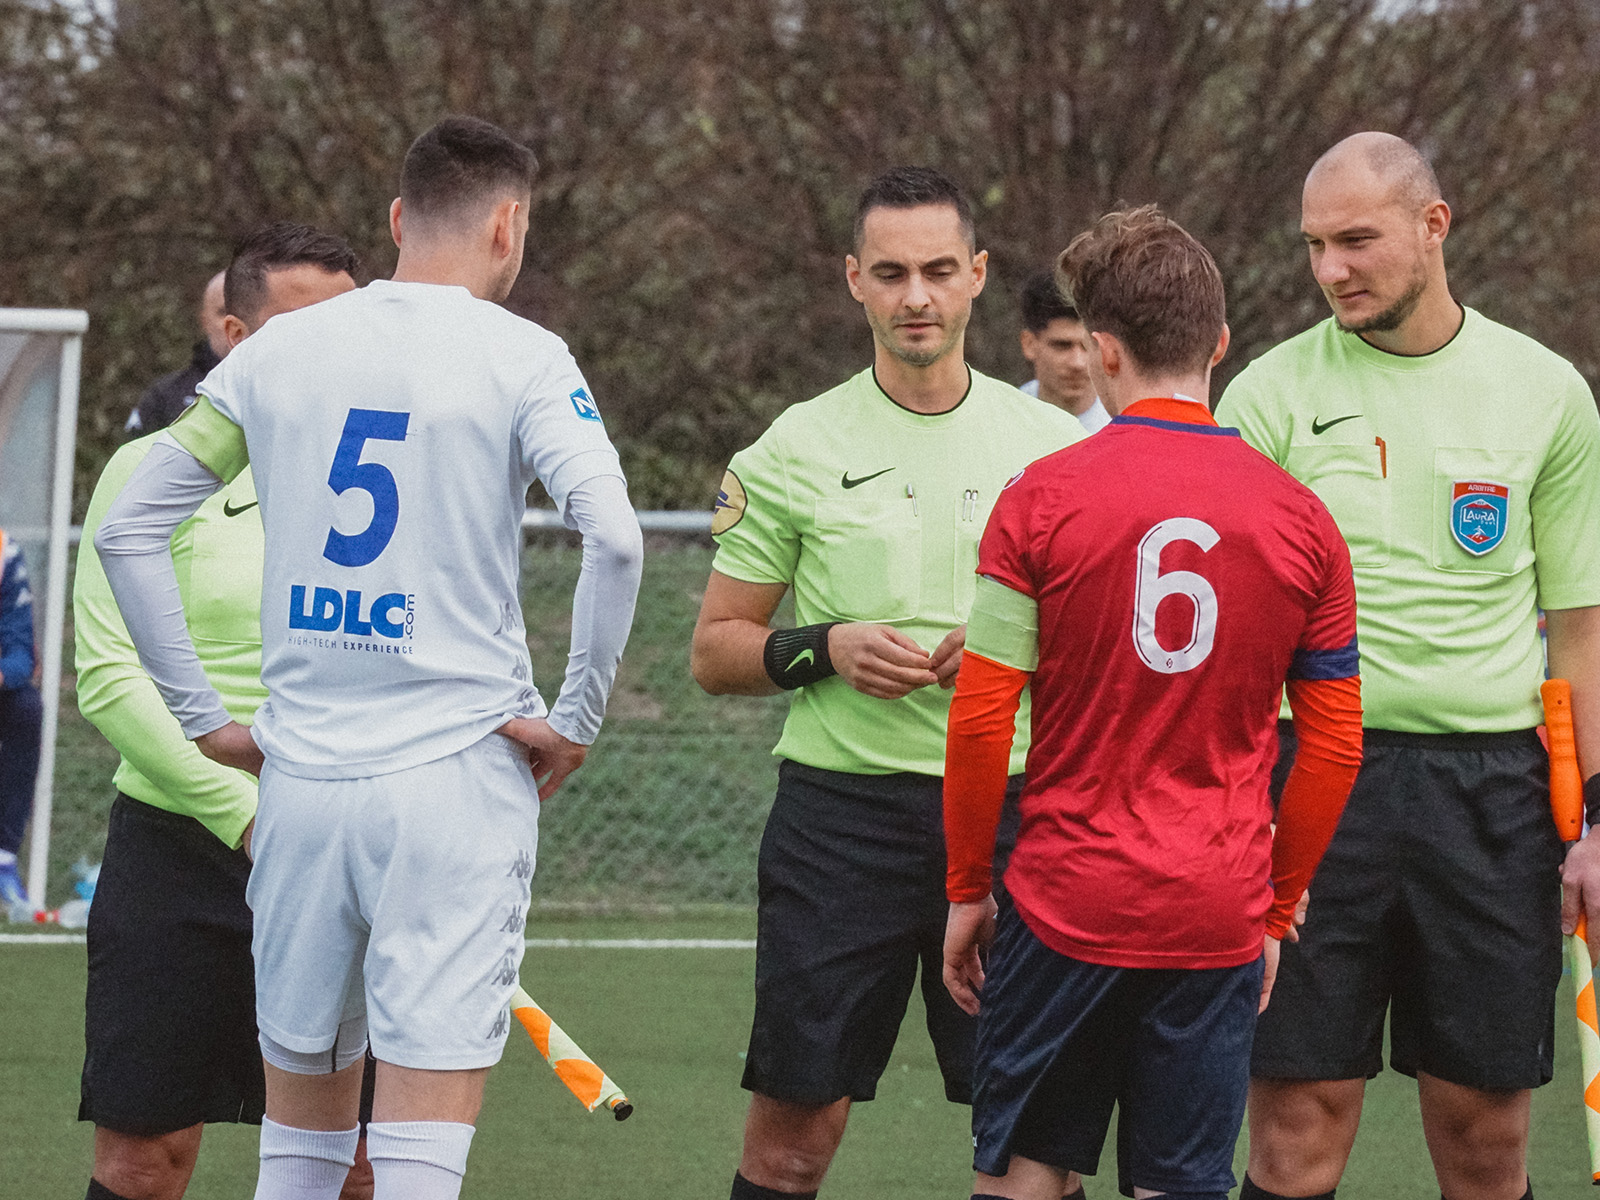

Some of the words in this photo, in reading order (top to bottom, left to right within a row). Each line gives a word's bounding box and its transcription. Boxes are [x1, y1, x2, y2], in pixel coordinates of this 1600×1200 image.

[323, 408, 410, 567] 5
[1468, 484, 1496, 492] ARBITRE
[289, 585, 406, 638] LDLC
[1132, 517, 1221, 674] 6
[288, 637, 337, 648] HIGH-TECH
[343, 641, 413, 654] EXPERIENCE
